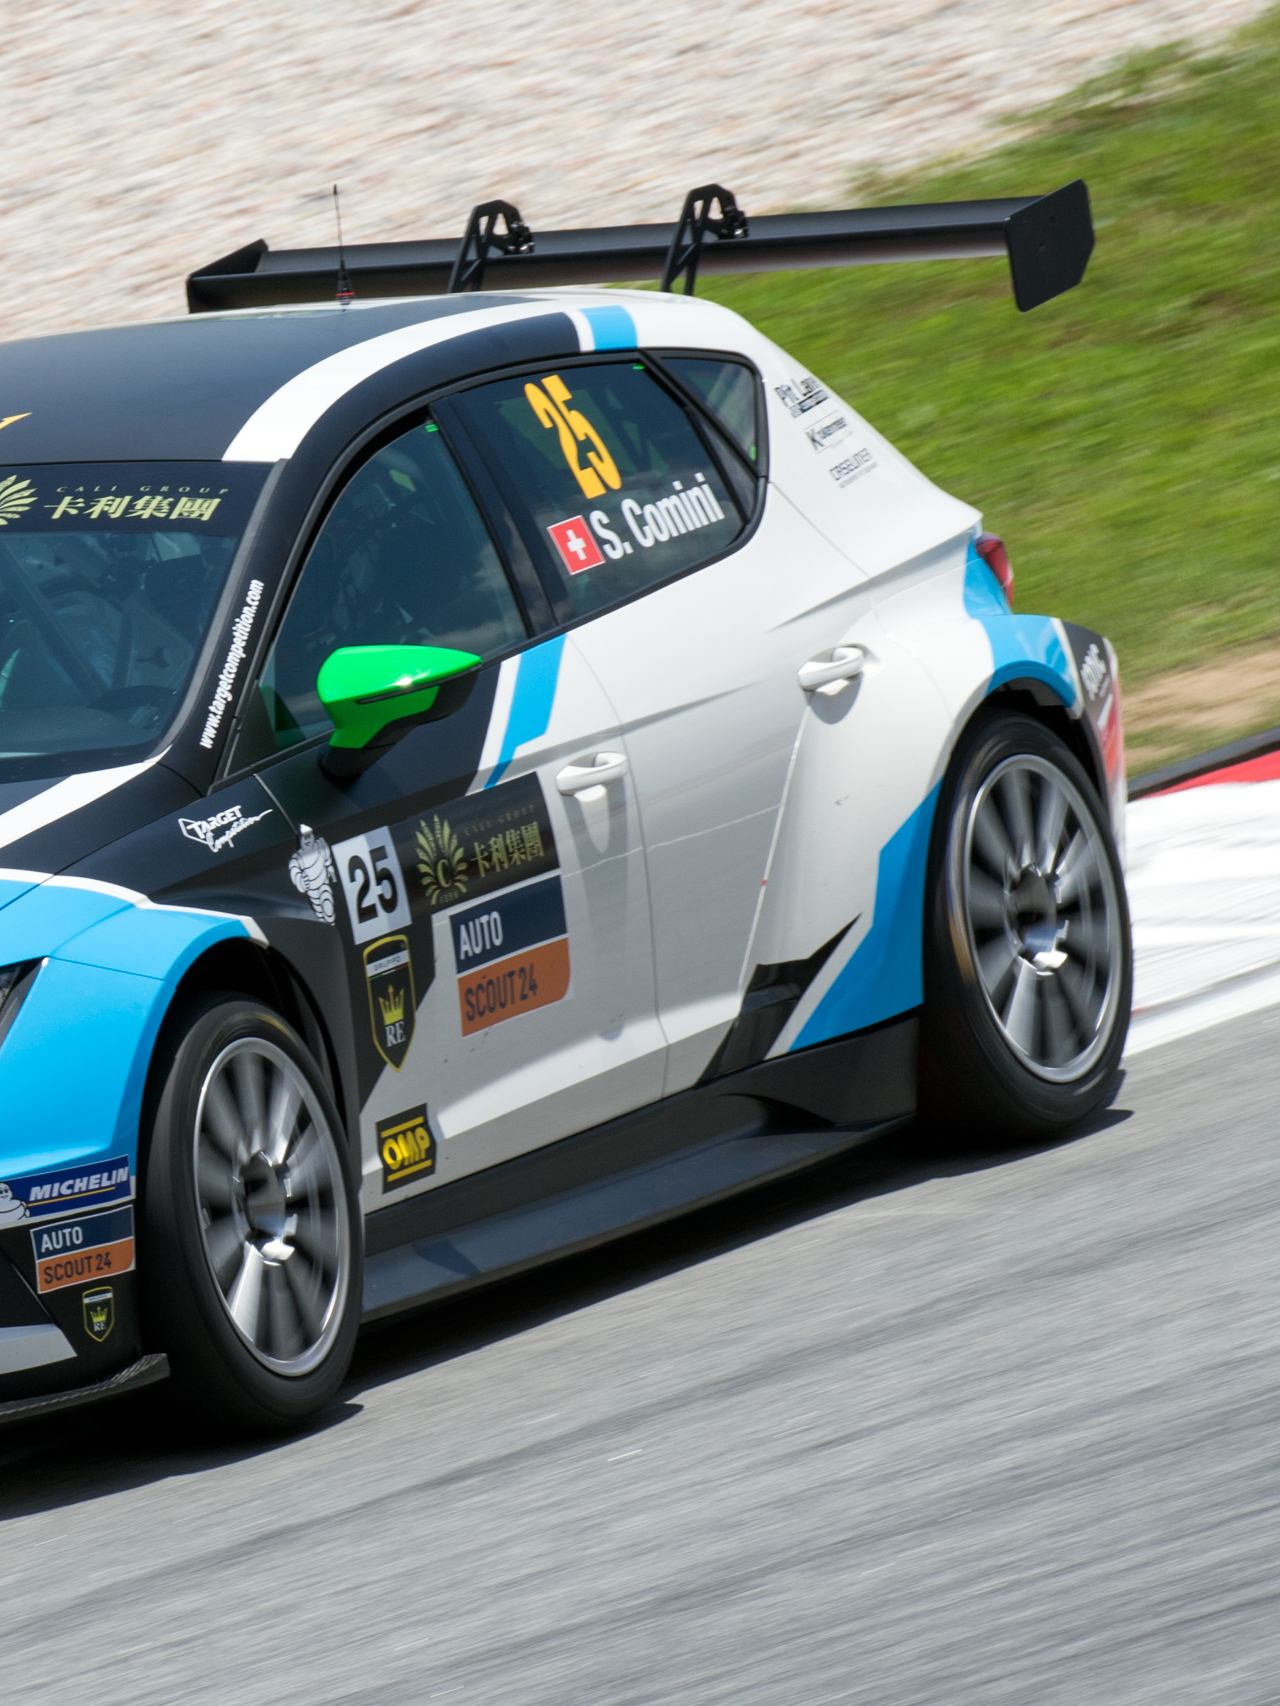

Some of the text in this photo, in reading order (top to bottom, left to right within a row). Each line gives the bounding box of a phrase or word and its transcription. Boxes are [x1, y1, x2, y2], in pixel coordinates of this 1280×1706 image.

[524, 374, 622, 499] 25
[43, 495, 222, 521] 卡利集團
[56, 484, 230, 494] CALI GROUP
[589, 472, 725, 559] S. Comini
[199, 579, 265, 749] www.targetcompetition.com
[186, 805, 243, 839] TARGET
[471, 820, 545, 877] 卡利集團
[348, 844, 399, 924] 25
[460, 911, 503, 960] AUTO
[385, 1021, 407, 1048] RE
[383, 1127, 431, 1170] OMP
[29, 1166, 130, 1202] MICHELIN
[40, 1226, 83, 1253] AUTO
[93, 1320, 108, 1332] RE
